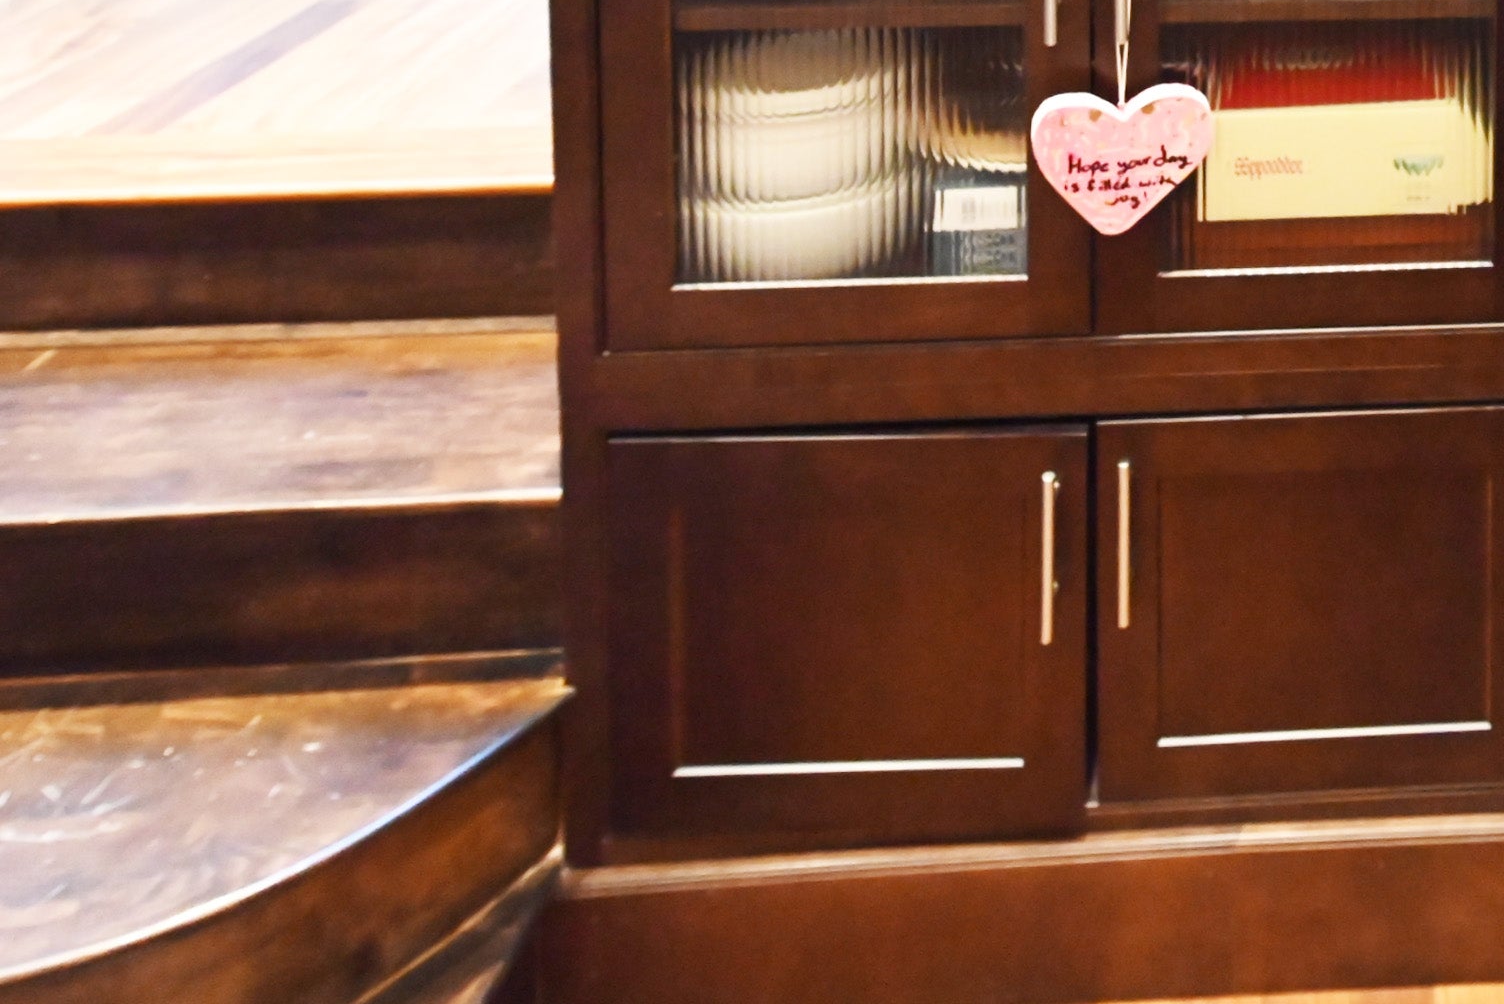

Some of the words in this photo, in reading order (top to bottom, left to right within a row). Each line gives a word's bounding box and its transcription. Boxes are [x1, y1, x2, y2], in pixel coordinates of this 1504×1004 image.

[1068, 153, 1109, 176] Hope
[1117, 156, 1151, 175] your
[1153, 144, 1192, 169] day
[1064, 181, 1080, 193] is
[1087, 176, 1130, 192] filled
[1138, 175, 1177, 188] with
